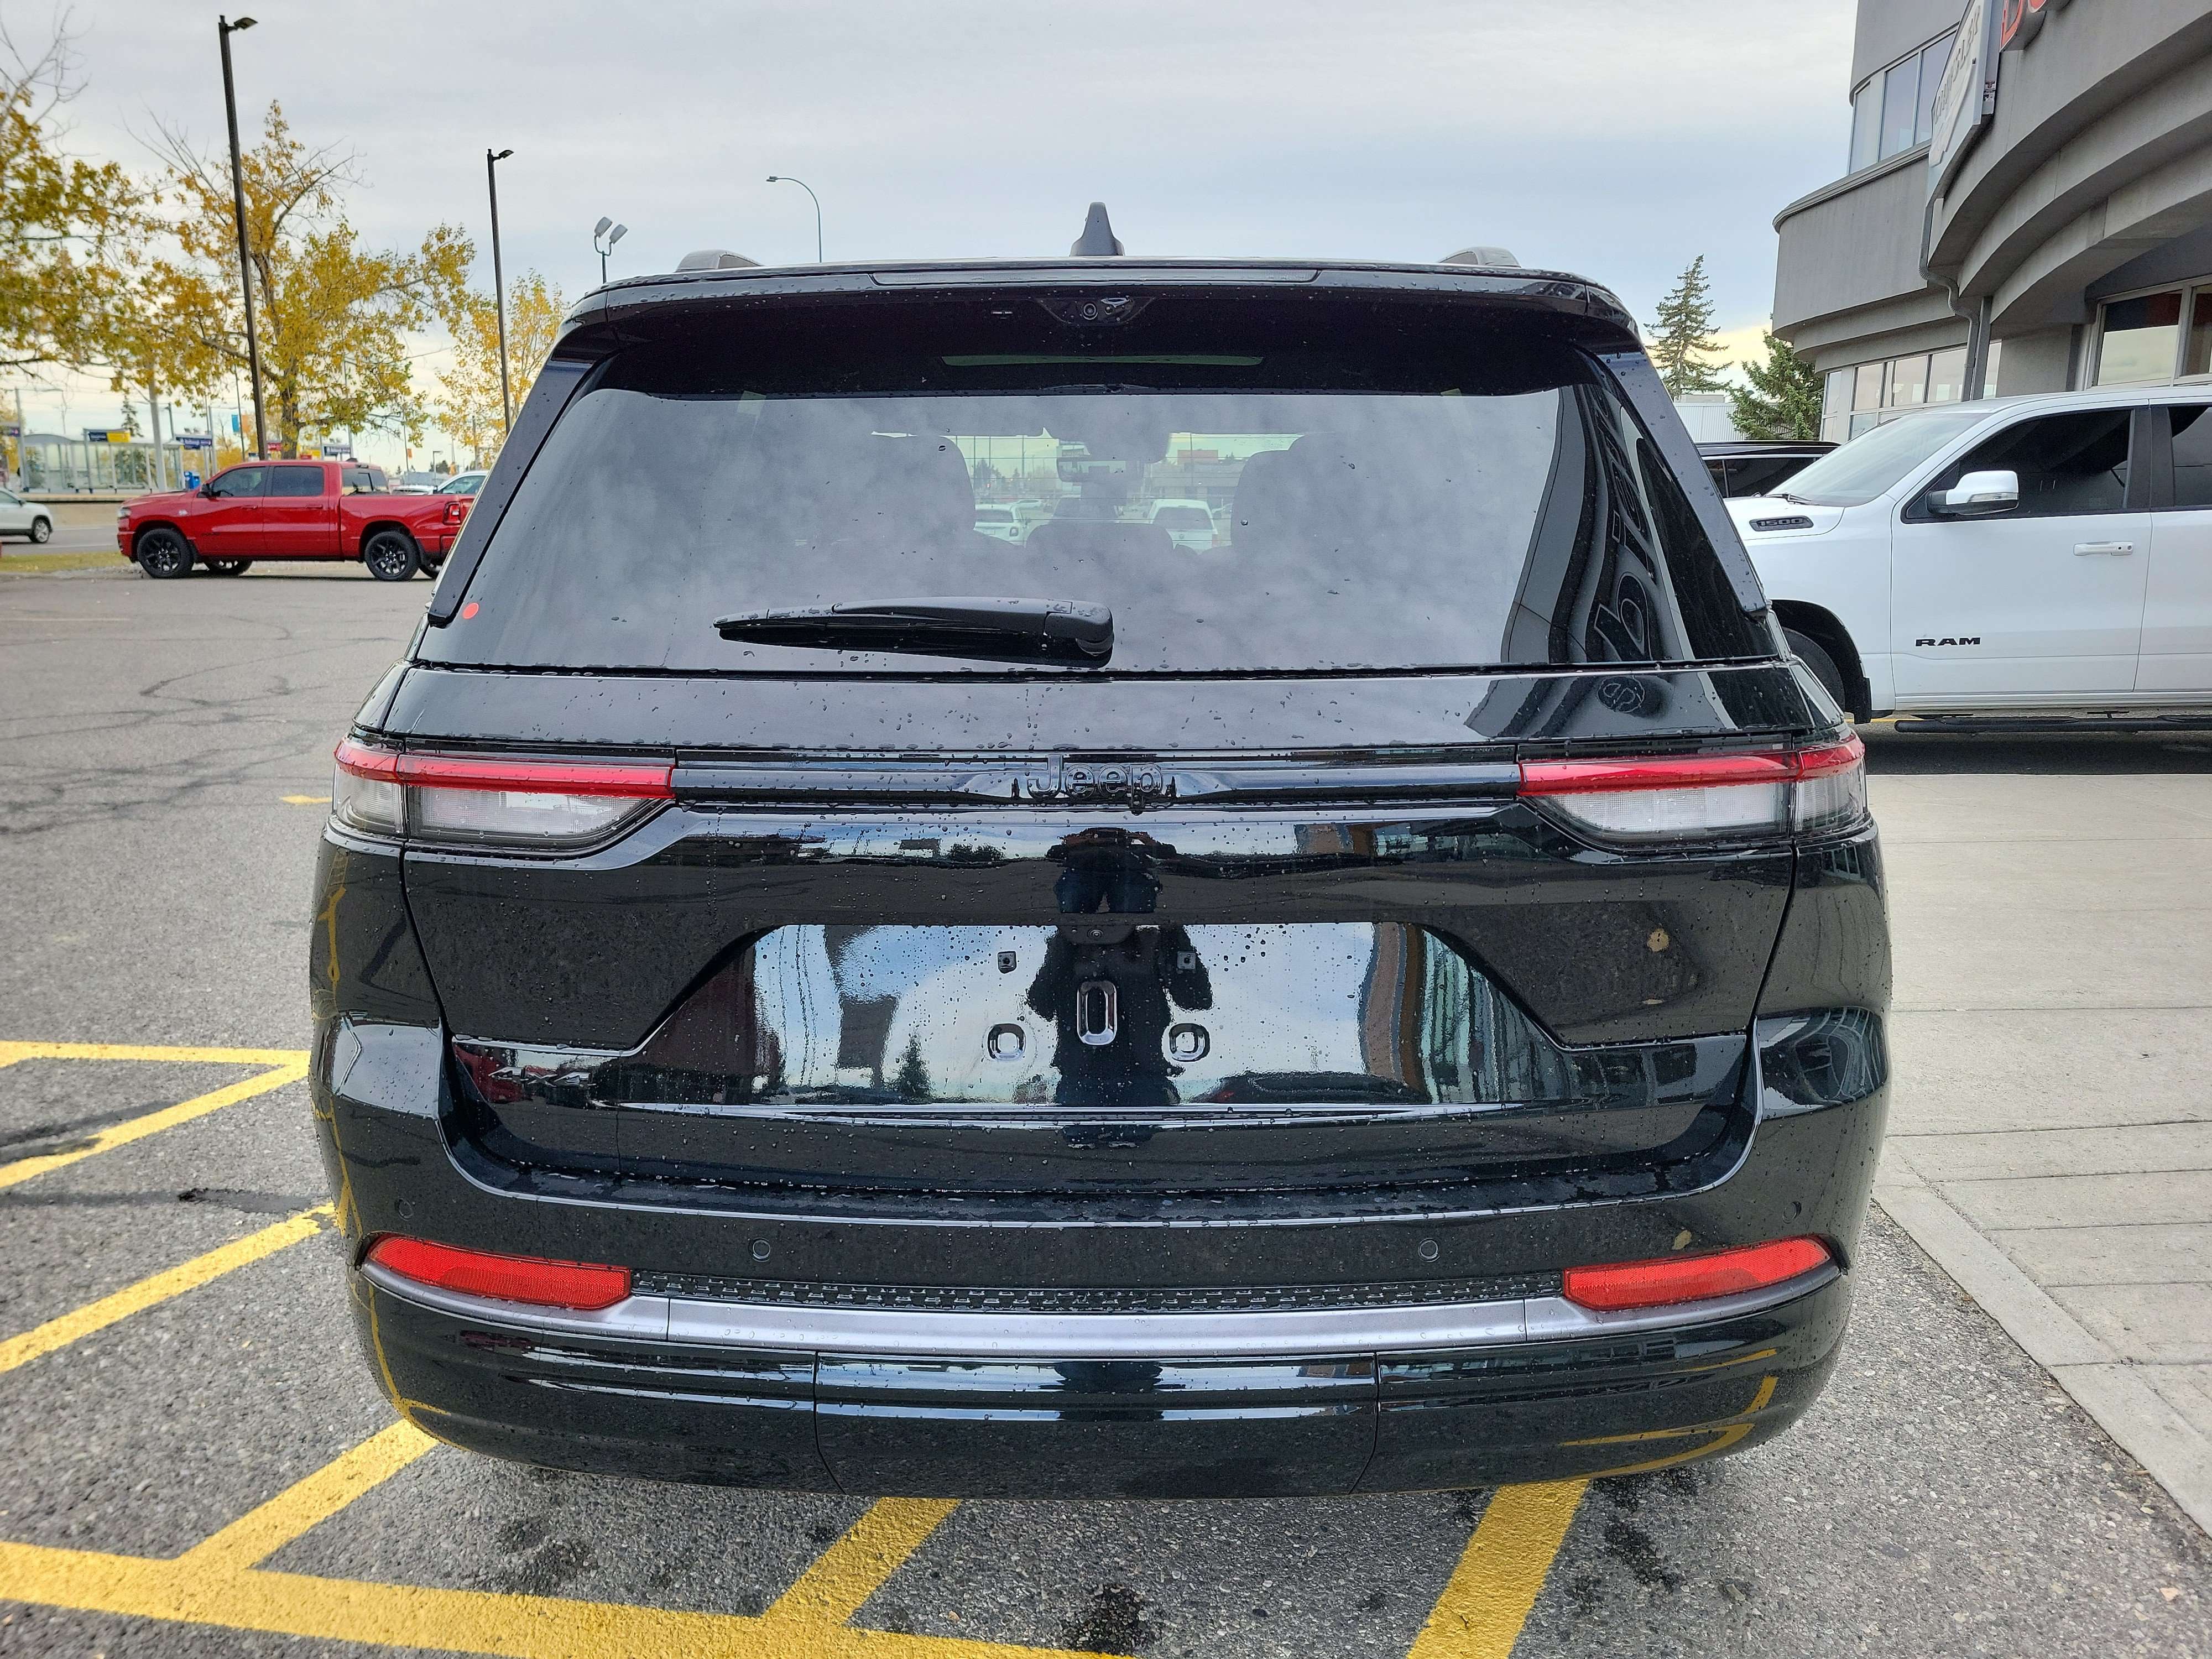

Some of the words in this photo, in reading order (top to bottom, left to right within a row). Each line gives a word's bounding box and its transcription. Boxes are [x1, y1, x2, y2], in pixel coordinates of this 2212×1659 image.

[1756, 518, 1804, 527] 1500
[1915, 637, 1981, 647] RAM
[1026, 754, 1164, 810] Jeep
